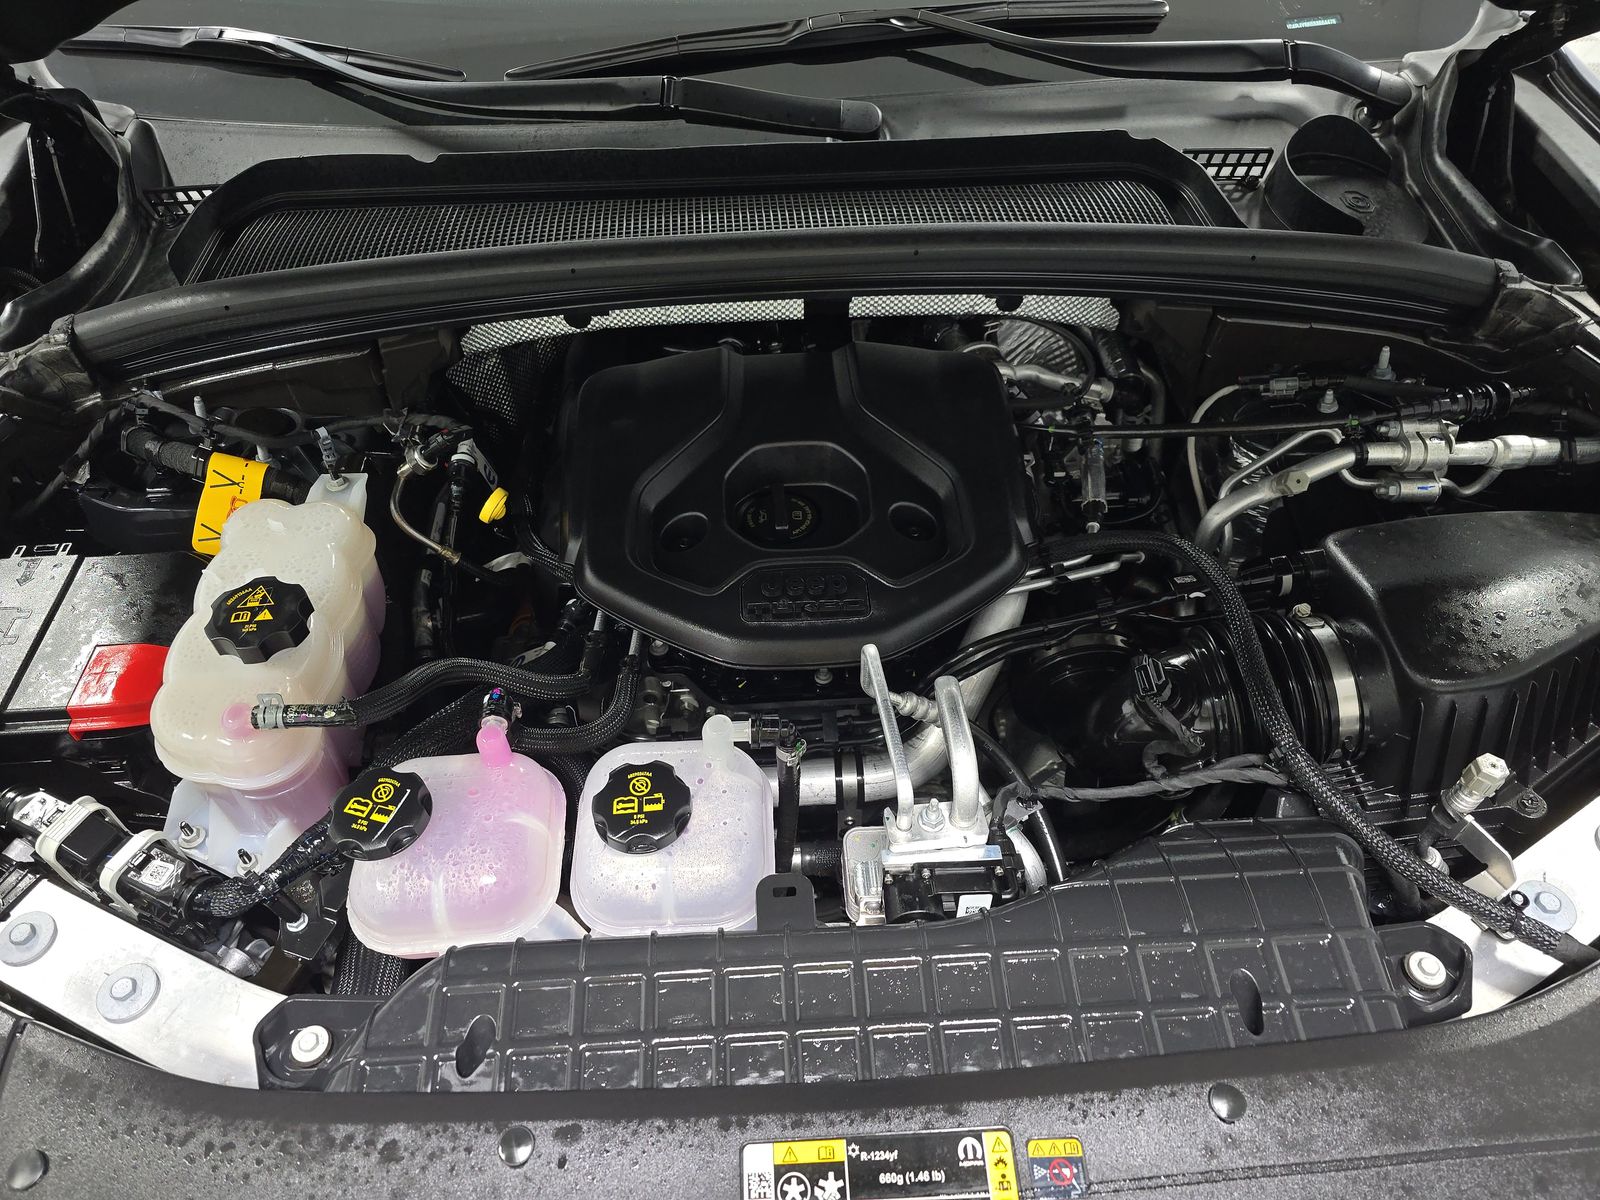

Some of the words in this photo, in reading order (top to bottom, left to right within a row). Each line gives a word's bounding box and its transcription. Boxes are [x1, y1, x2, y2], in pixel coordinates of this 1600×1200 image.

[860, 1149, 899, 1161] R-1234yf
[879, 1172, 903, 1186] 660g
[932, 1170, 946, 1183] lb)
